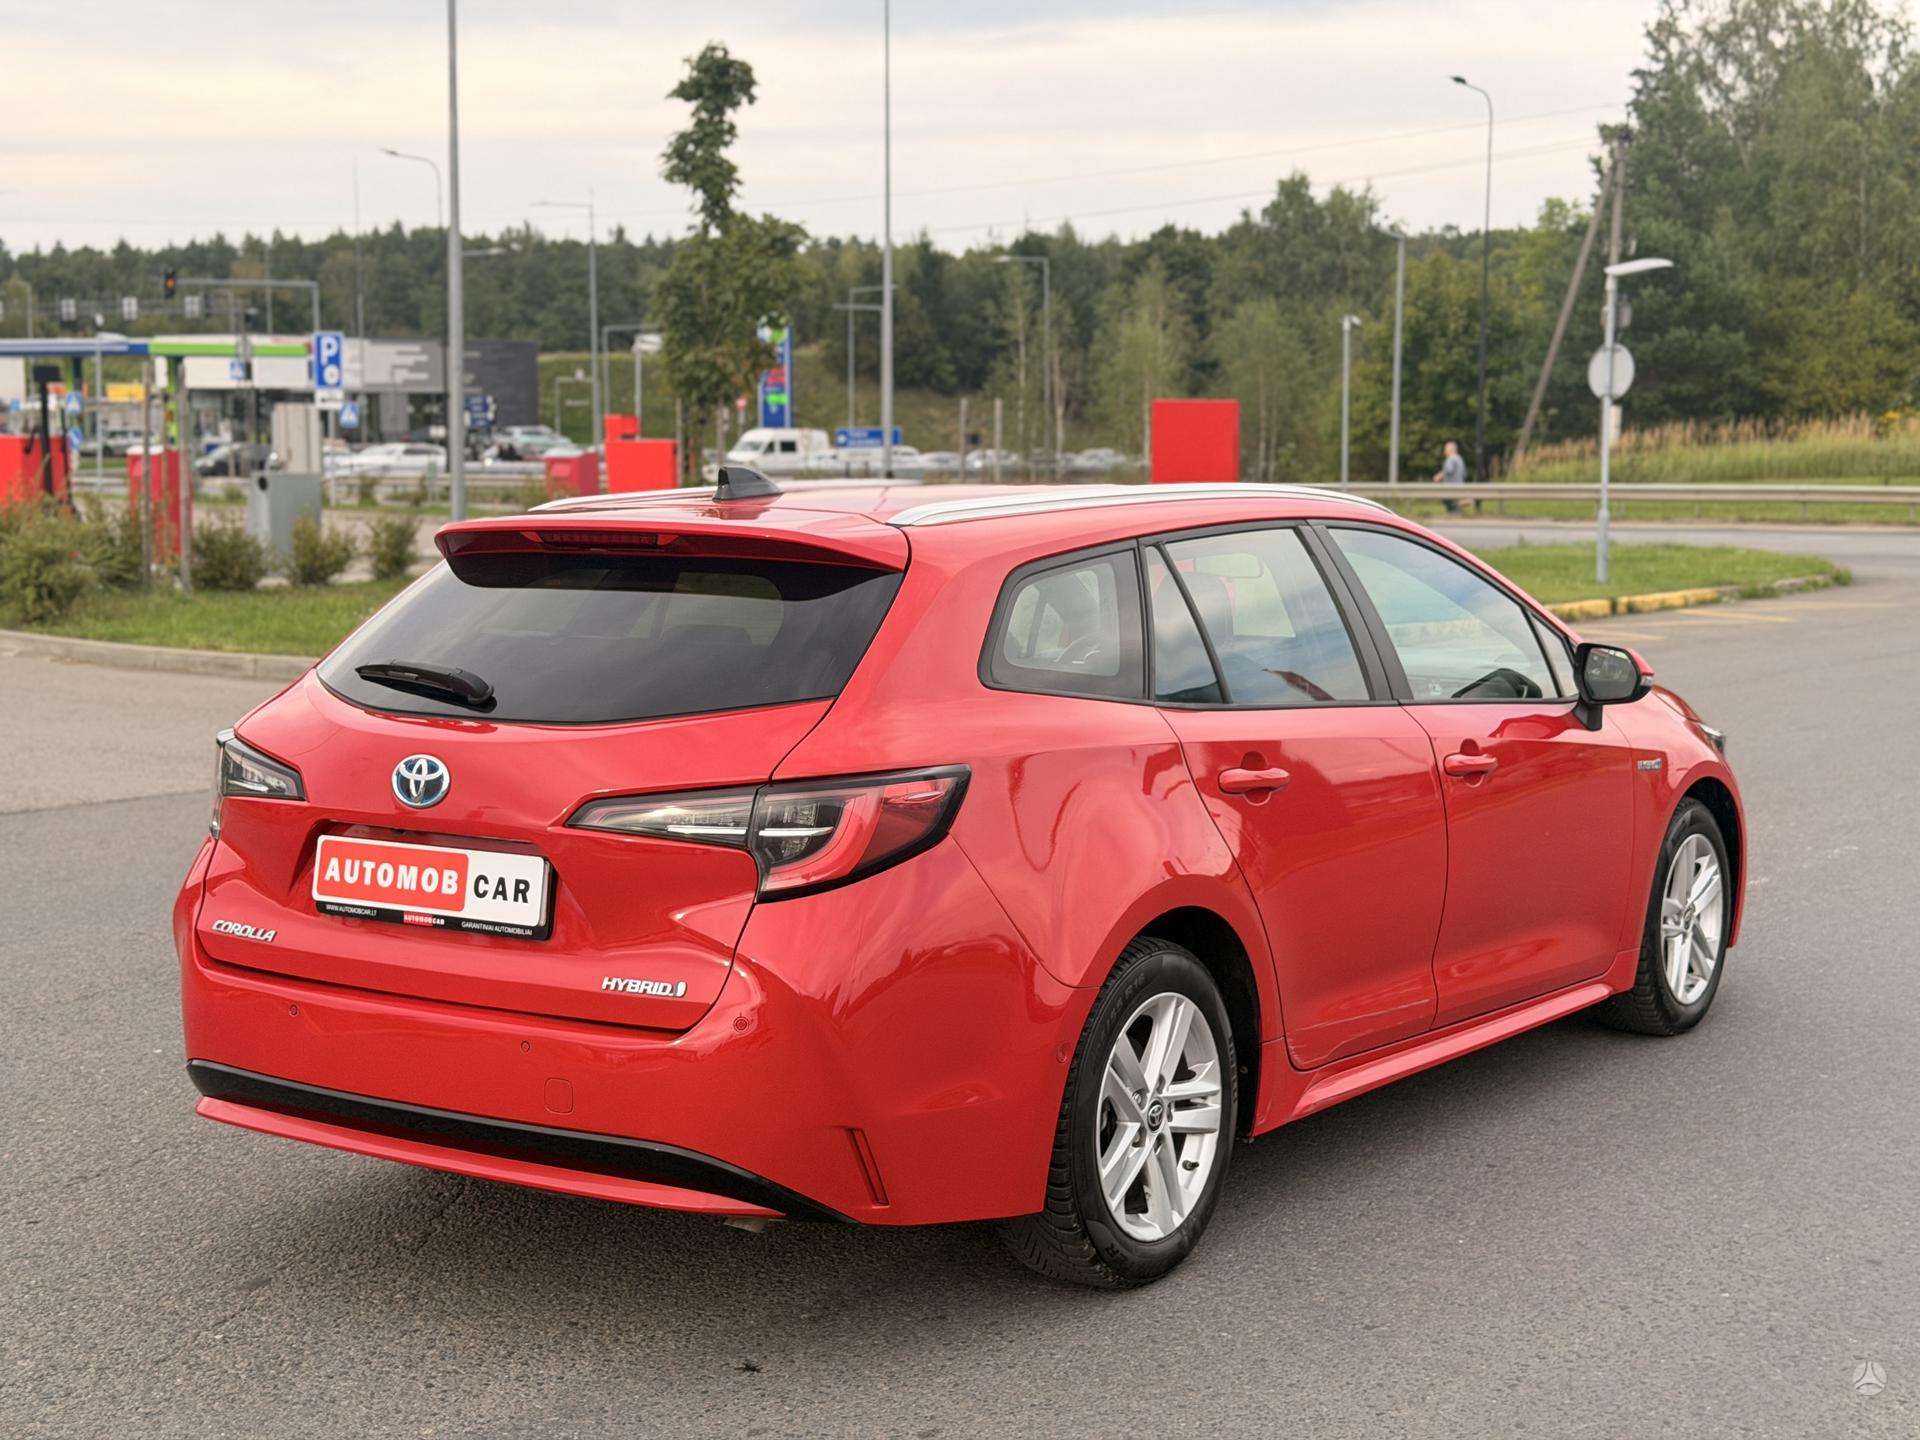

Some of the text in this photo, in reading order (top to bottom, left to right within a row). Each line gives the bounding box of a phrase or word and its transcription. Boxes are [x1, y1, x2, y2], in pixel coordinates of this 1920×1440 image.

[319, 335, 339, 367] P
[324, 856, 531, 904] AUTOMOB CAR
[211, 919, 278, 943] COROLLA
[601, 976, 674, 997] HYBRID
